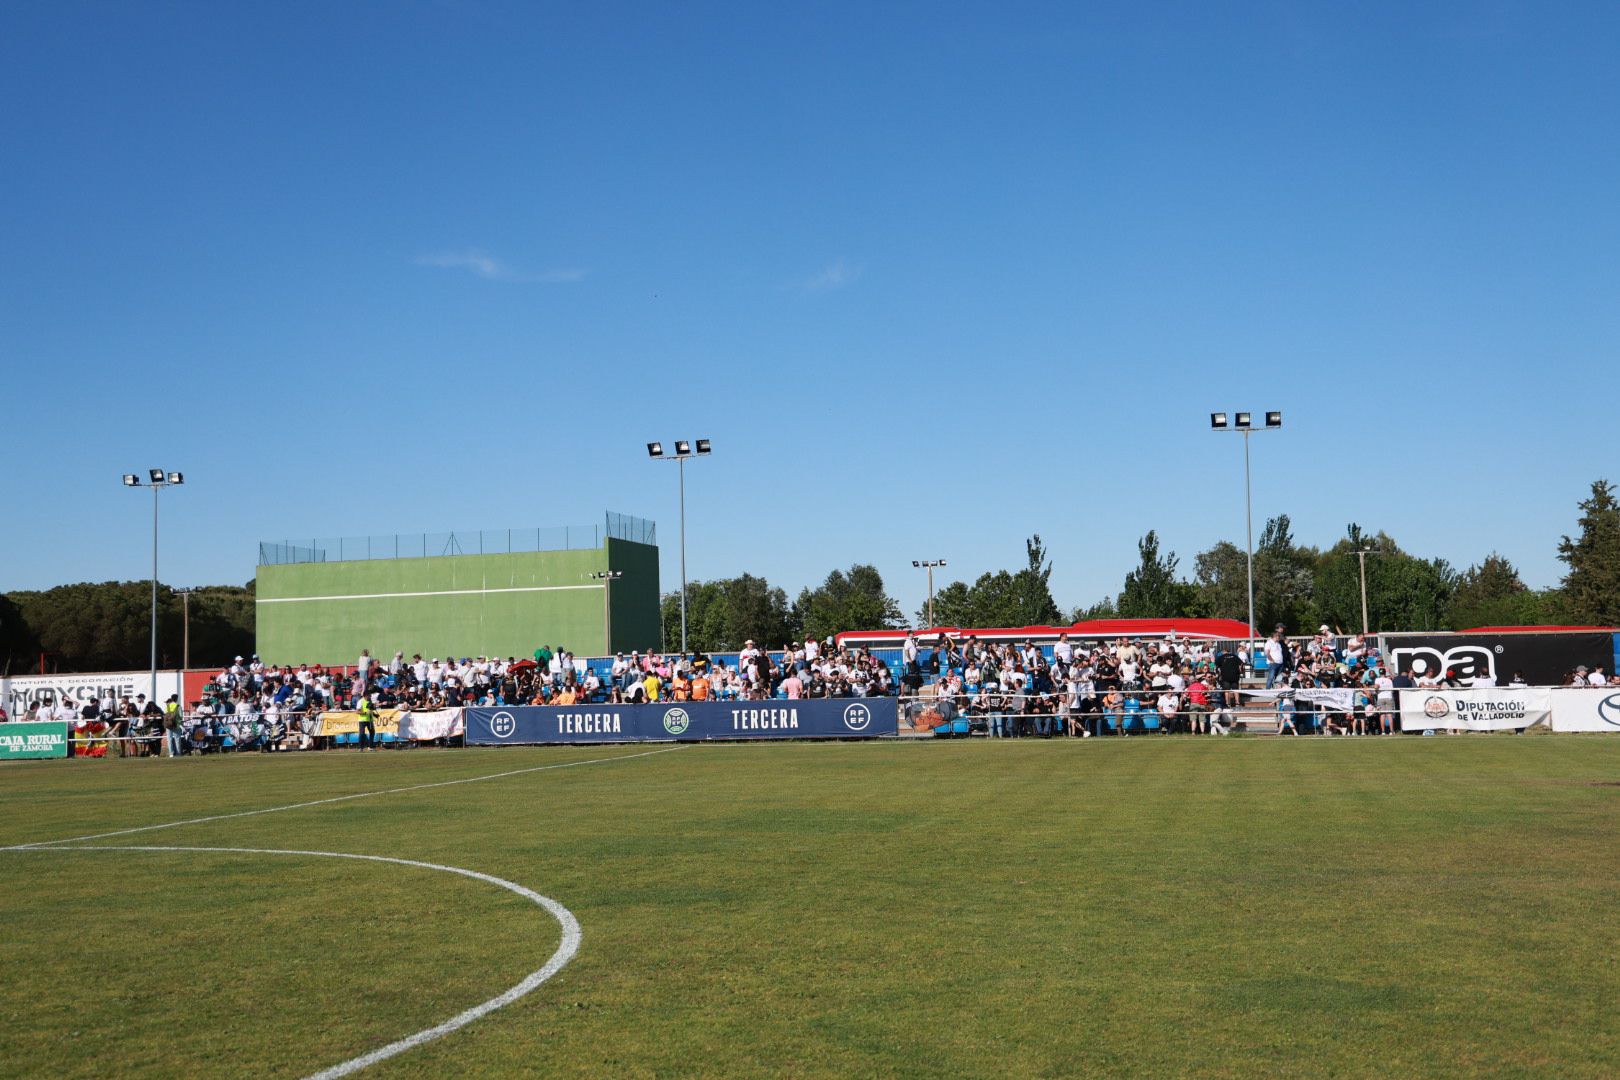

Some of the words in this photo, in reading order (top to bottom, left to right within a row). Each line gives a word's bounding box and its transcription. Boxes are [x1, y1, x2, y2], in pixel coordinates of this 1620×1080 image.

[1456, 700, 1525, 711] DIPUTACIÓN
[732, 709, 799, 729] TERCERA
[1471, 711, 1525, 721] VALLADOLID
[557, 713, 621, 734] TERCERA
[0, 735, 25, 746] CAJA
[27, 734, 65, 745] RURAL
[22, 744, 53, 752] ZAMORA
